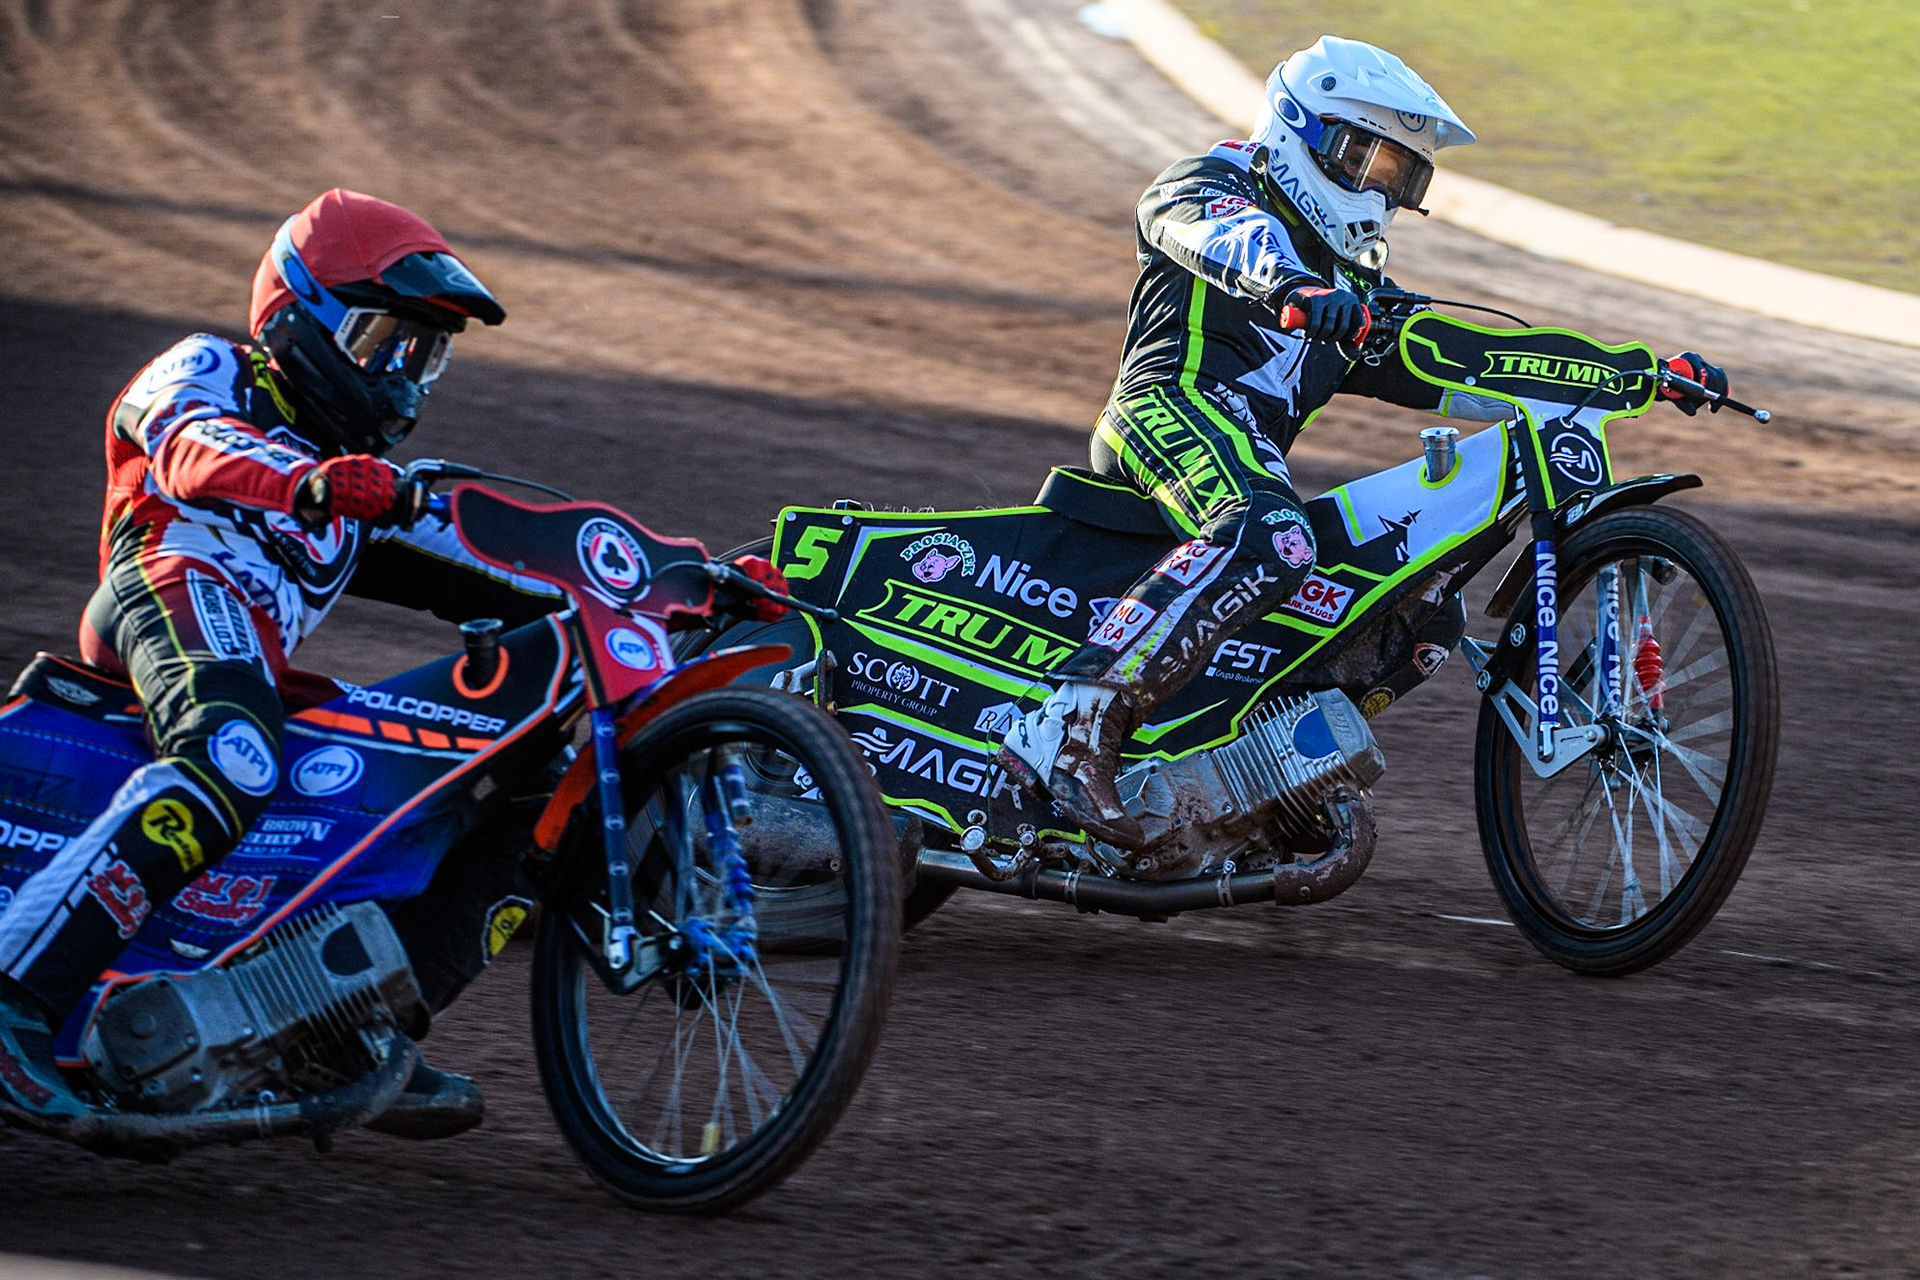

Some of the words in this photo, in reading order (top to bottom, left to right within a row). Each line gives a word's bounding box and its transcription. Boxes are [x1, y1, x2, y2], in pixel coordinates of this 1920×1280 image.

[783, 525, 845, 580] 5
[900, 533, 977, 577] PROSIACZEK
[974, 554, 1078, 618] Nice
[1300, 579, 1347, 612] GK
[1535, 552, 1558, 628] Nice
[1304, 604, 1334, 620] PLUGS
[1211, 639, 1282, 673] FST
[1538, 640, 1560, 715] Nice
[846, 652, 960, 708] SCOTT
[851, 679, 901, 704] PROPERTY
[901, 698, 938, 717] GROUP
[347, 690, 507, 733] POLCOPPER
[222, 735, 269, 777] ATPI
[303, 761, 348, 778] ATPI
[850, 727, 1023, 811] MAGIK
[0, 818, 66, 853] OPP
